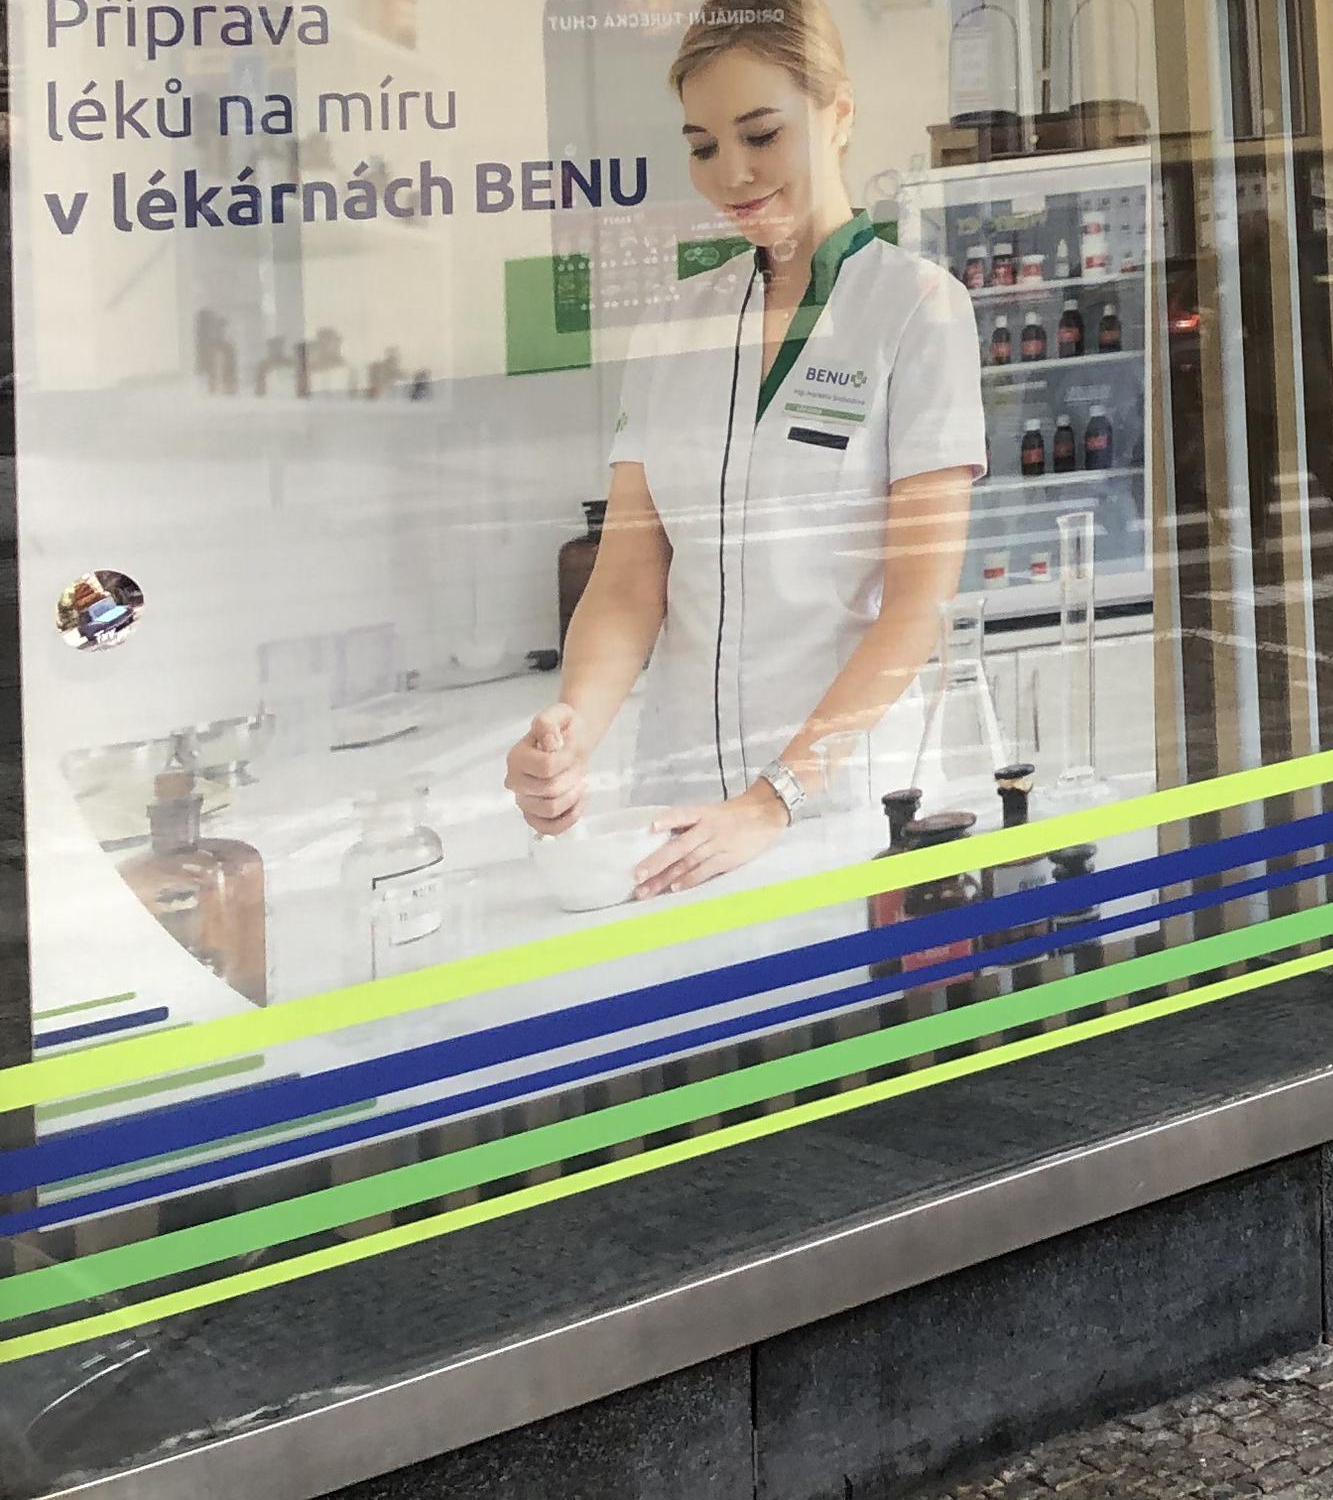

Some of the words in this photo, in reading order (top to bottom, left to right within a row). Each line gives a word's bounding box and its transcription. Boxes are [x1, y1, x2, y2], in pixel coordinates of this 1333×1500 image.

[45, 79, 192, 142] léků
[219, 92, 292, 135] na
[320, 77, 457, 133] míru
[44, 191, 89, 235] v
[114, 159, 452, 232] lékárnách
[477, 158, 648, 213] BENU
[806, 367, 849, 385] BENU
